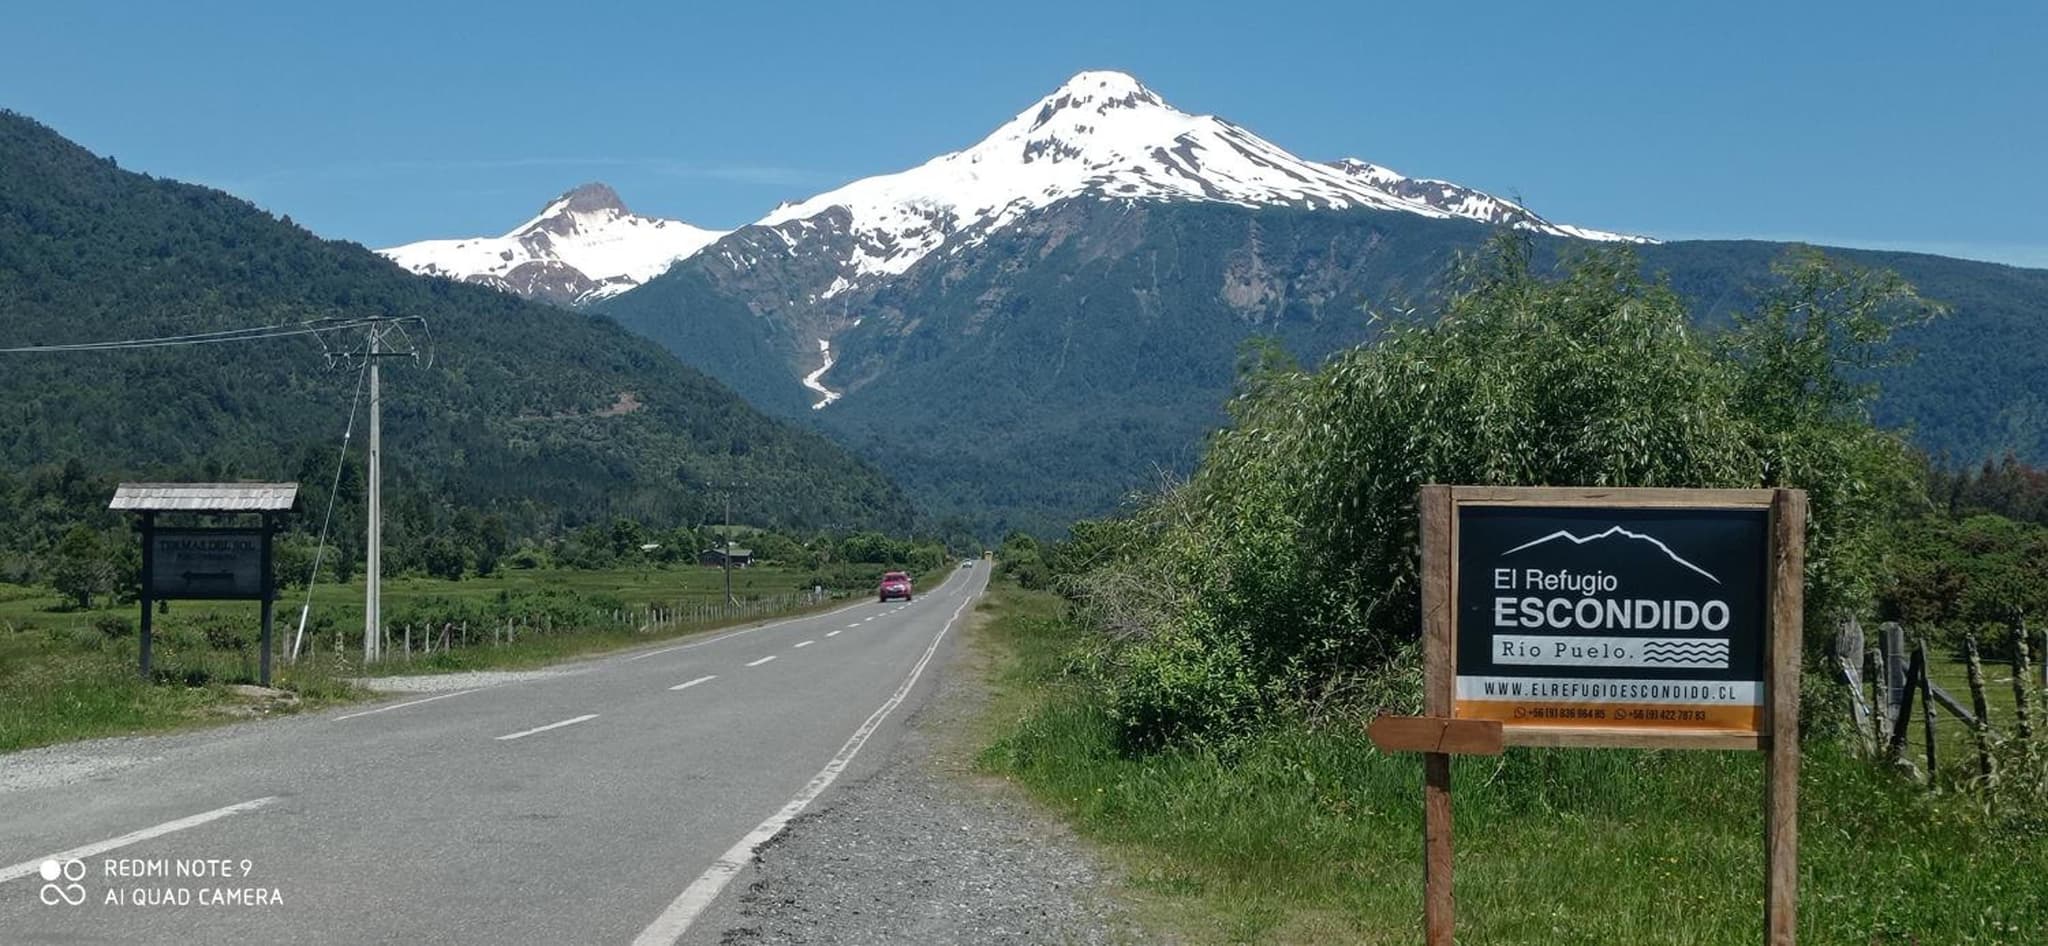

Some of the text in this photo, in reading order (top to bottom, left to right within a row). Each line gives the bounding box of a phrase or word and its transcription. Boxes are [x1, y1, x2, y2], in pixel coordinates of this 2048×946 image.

[1494, 568, 1618, 596] El Refugio
[1494, 597, 1731, 631] ESCONDIDO
[1502, 641, 1635, 660] Río Puelo.
[1484, 682, 1737, 701] WWW.ELREFUGIOESCONDIDO.CL
[1660, 709, 1676, 721] 422
